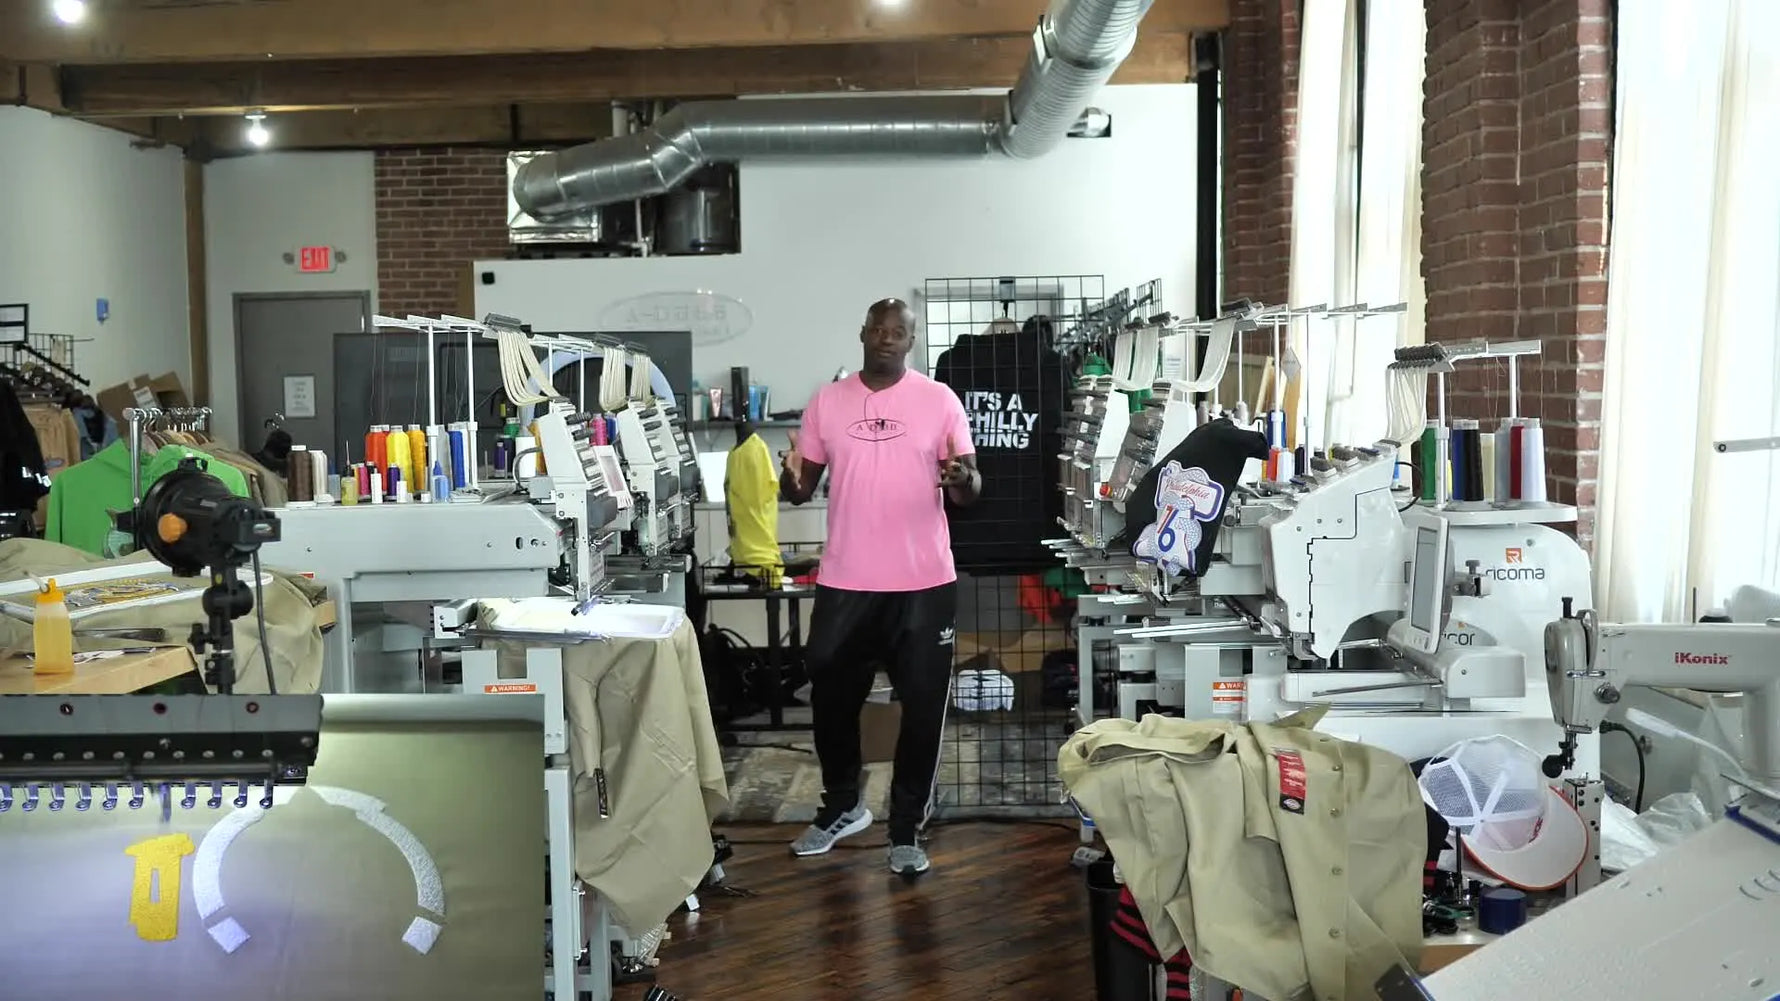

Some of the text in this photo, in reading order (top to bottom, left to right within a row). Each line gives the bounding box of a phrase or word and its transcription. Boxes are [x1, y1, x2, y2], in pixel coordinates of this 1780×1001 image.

[301, 246, 330, 270] EXIT
[965, 391, 1023, 411] IT'S A
[1674, 651, 1728, 665] iKonix
